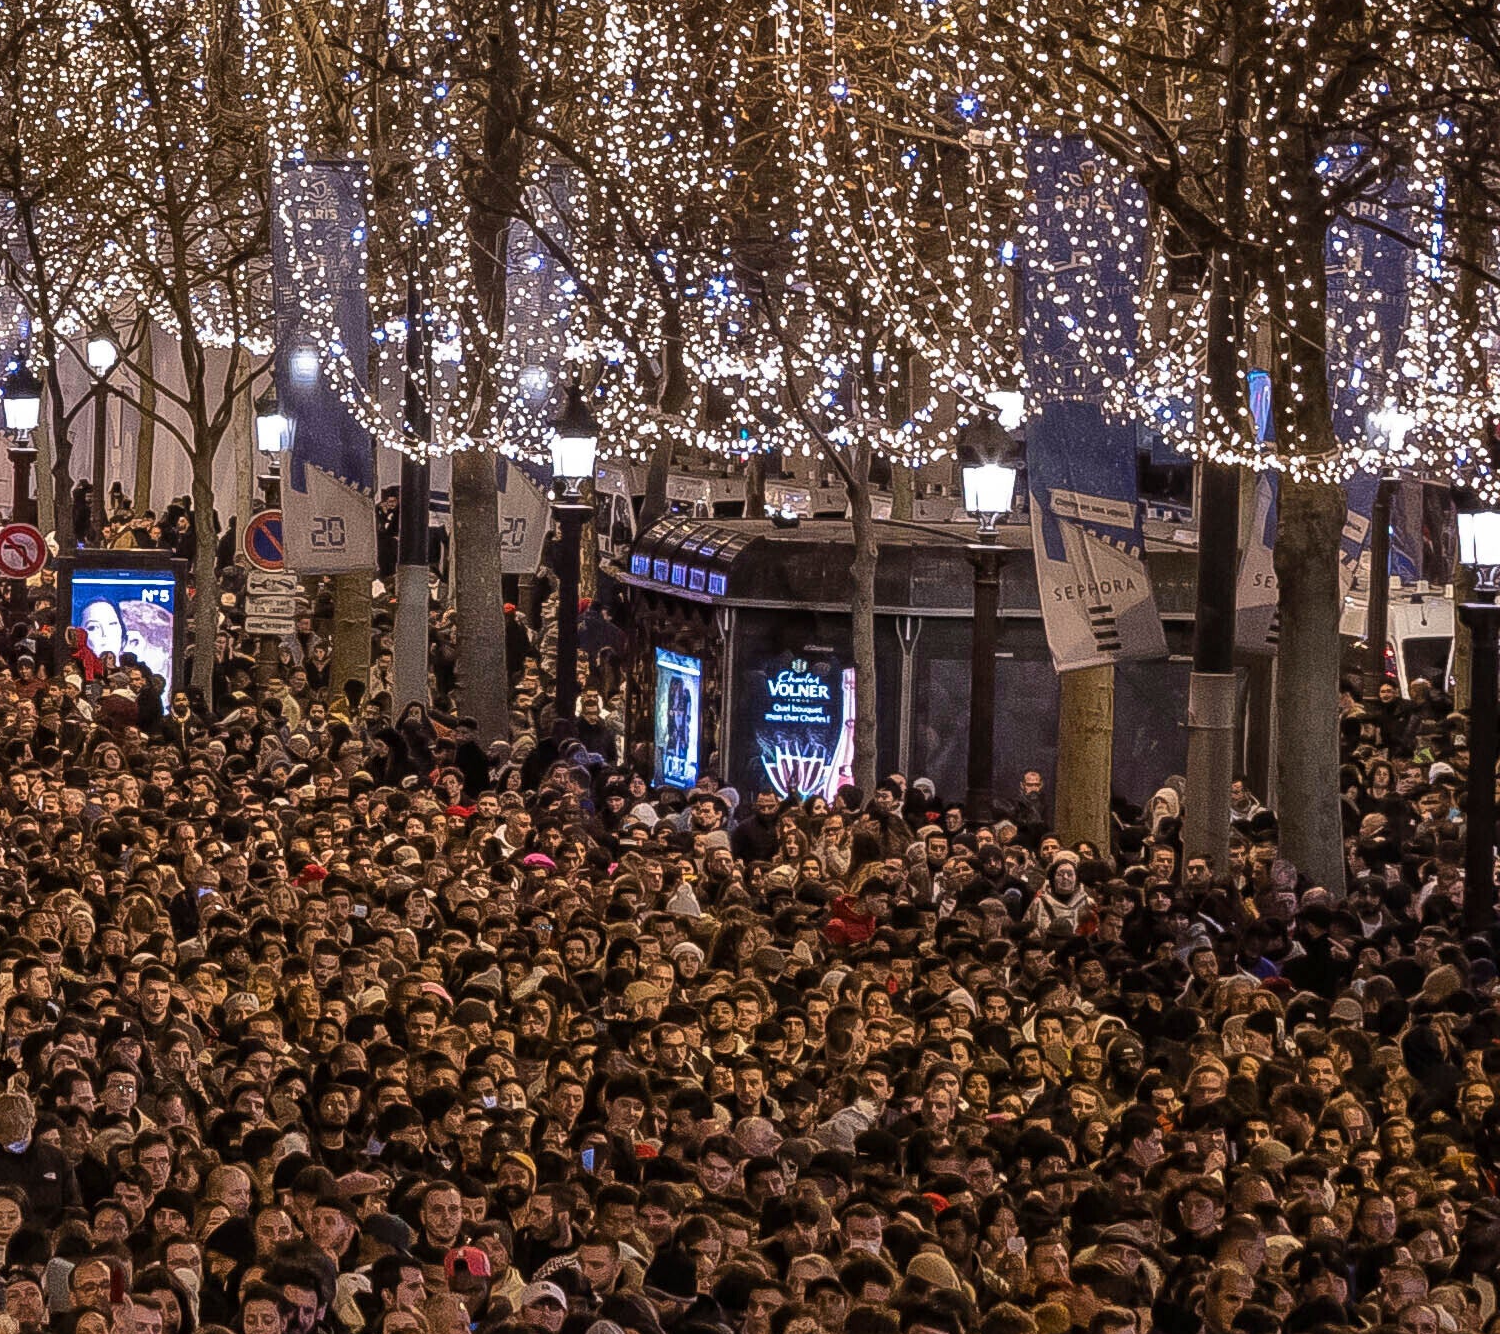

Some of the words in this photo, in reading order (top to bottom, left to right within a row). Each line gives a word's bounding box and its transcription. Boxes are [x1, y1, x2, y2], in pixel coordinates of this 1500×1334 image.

[311, 517, 346, 547] 20
[501, 517, 526, 547] 20
[1252, 572, 1276, 589] SE
[141, 589, 170, 603] N°5
[1054, 577, 1137, 603] SEPHORA
[779, 670, 820, 684] Charles
[768, 680, 831, 700] VOLNER
[773, 703, 790, 713] Quel
[791, 704, 822, 715] bouquet
